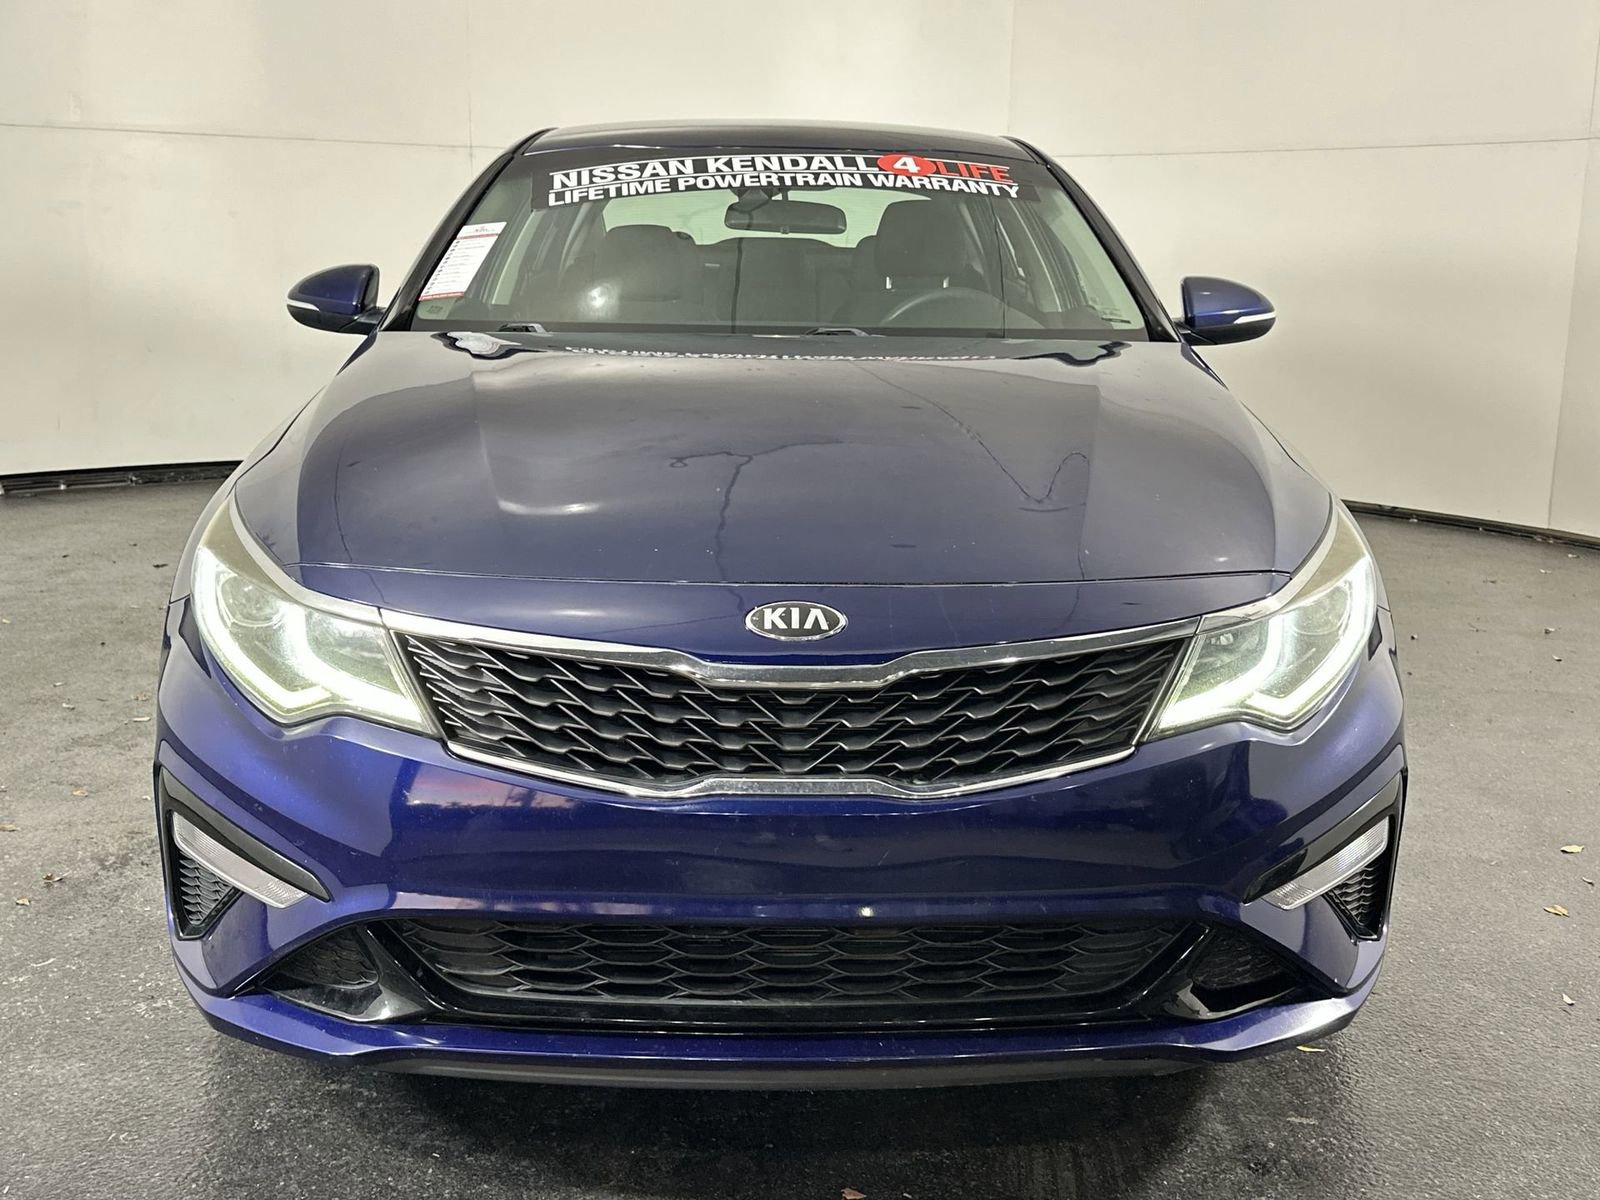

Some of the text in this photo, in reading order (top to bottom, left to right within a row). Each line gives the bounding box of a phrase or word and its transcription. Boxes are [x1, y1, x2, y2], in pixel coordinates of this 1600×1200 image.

[552, 156, 1013, 189] NISSAN KENDALL 4 LIFE
[548, 173, 1019, 206] LIFETIME POWERTRAIN WARRANTY
[762, 607, 829, 630] KIA
